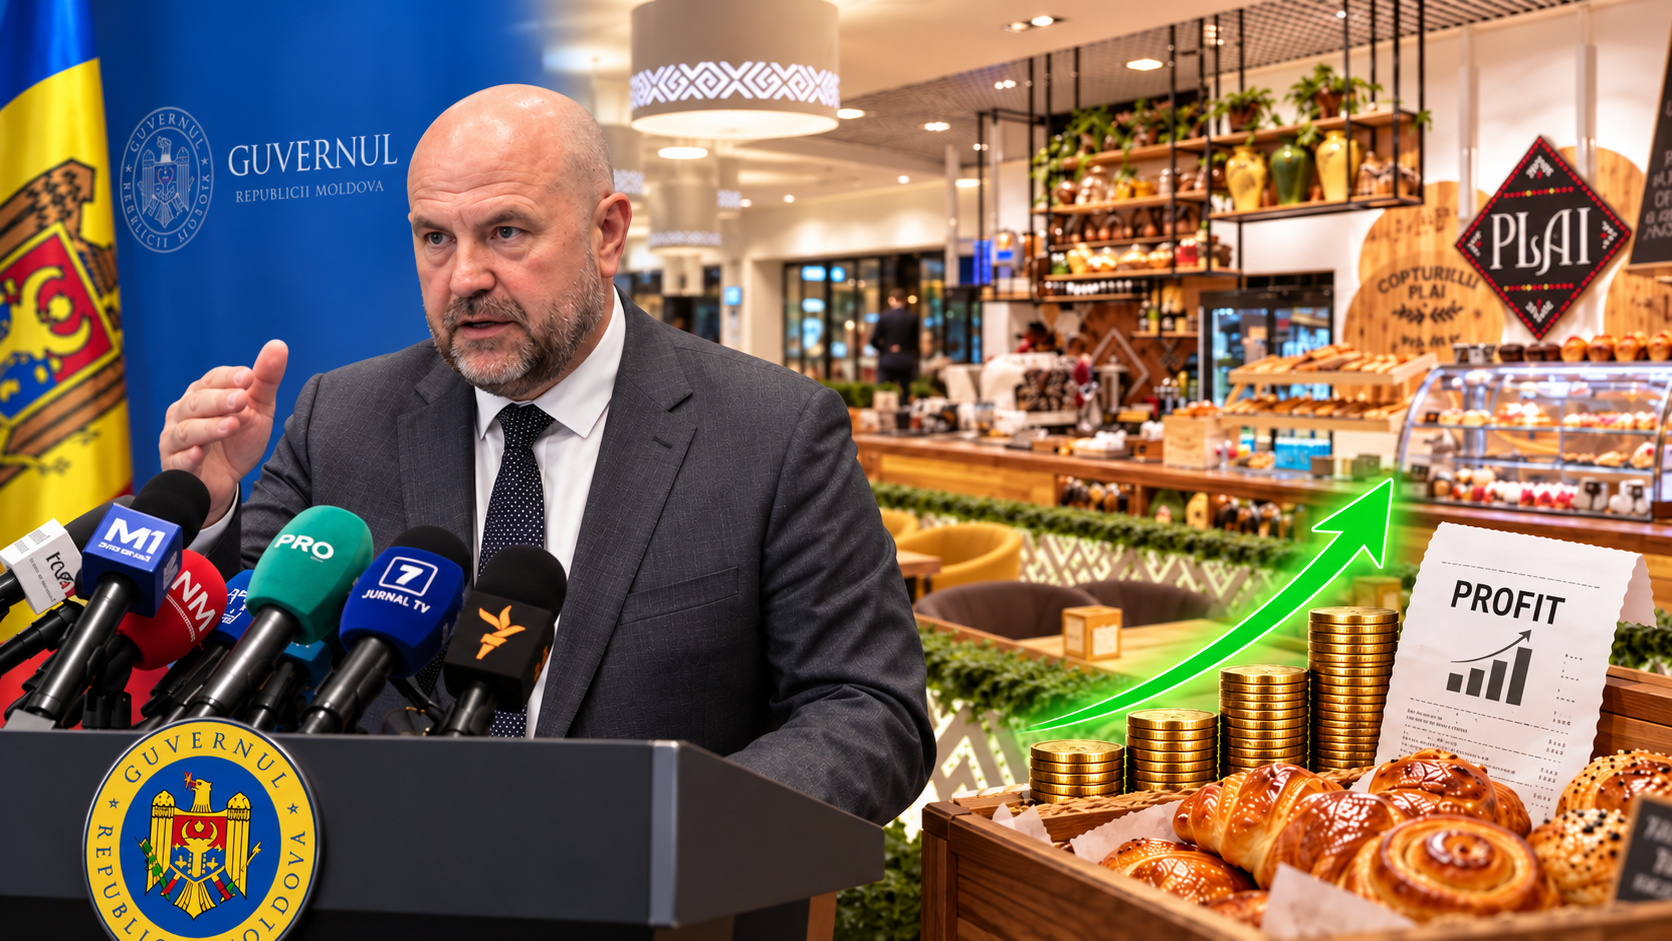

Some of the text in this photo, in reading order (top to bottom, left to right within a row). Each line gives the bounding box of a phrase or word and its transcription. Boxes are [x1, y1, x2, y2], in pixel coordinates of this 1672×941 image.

[130, 112, 204, 153] GUVERNUL
[228, 133, 399, 177] GUVERNUL
[235, 180, 384, 203] REPUBLICII MOLDOVA
[1408, 284, 1446, 300] PLAI
[103, 517, 166, 555] M1
[274, 534, 334, 560] PRO
[395, 564, 424, 586] 7
[361, 588, 431, 614] JURNAL TV
[1450, 579, 1566, 625] PROFIT
[124, 731, 288, 788] GUVERNUL
[96, 824, 164, 941] REPUBLI
[231, 831, 306, 941] OLDOVA
